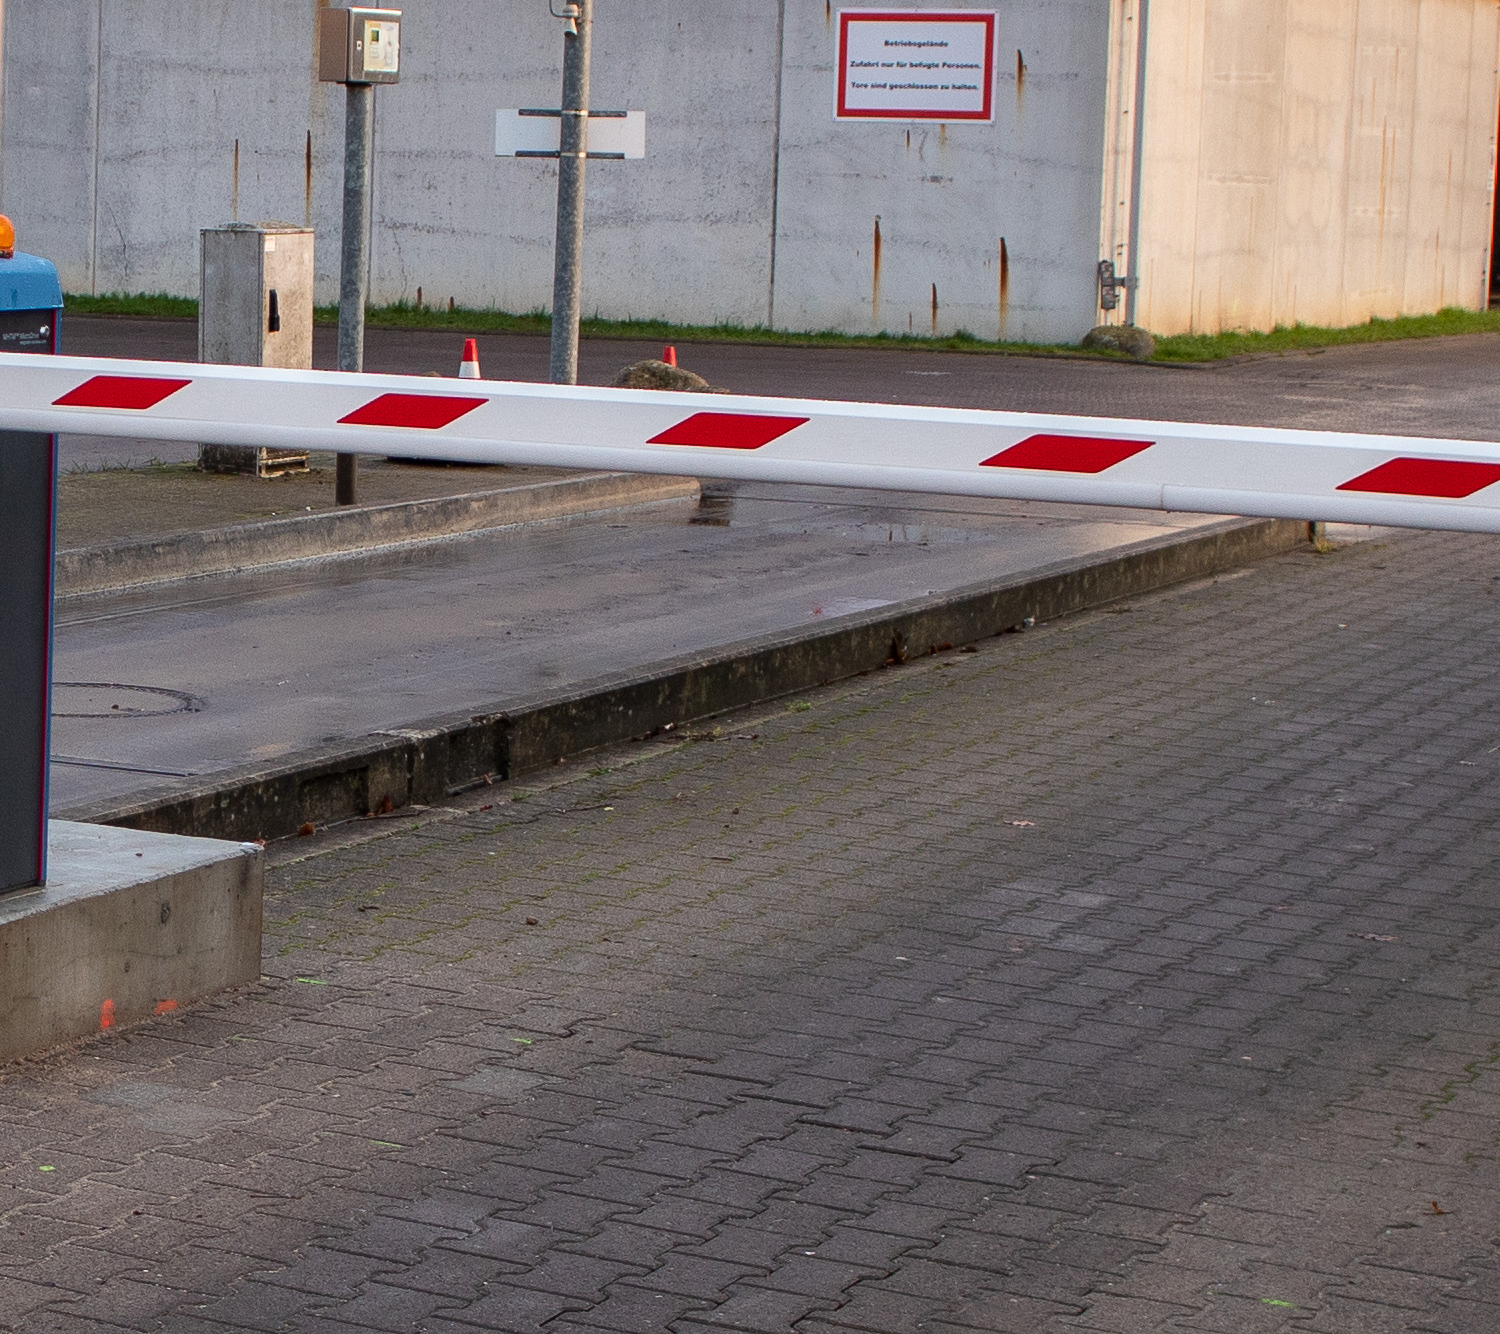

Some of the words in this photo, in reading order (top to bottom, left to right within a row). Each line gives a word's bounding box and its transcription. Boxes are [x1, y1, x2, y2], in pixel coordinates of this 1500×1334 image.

[883, 39, 949, 48] Betriebsgelände
[850, 60, 880, 68] Zufahrt
[896, 60, 908, 68] für
[909, 61, 940, 69] befugte
[851, 81, 869, 89] Tore
[888, 82, 938, 91] geschlossen
